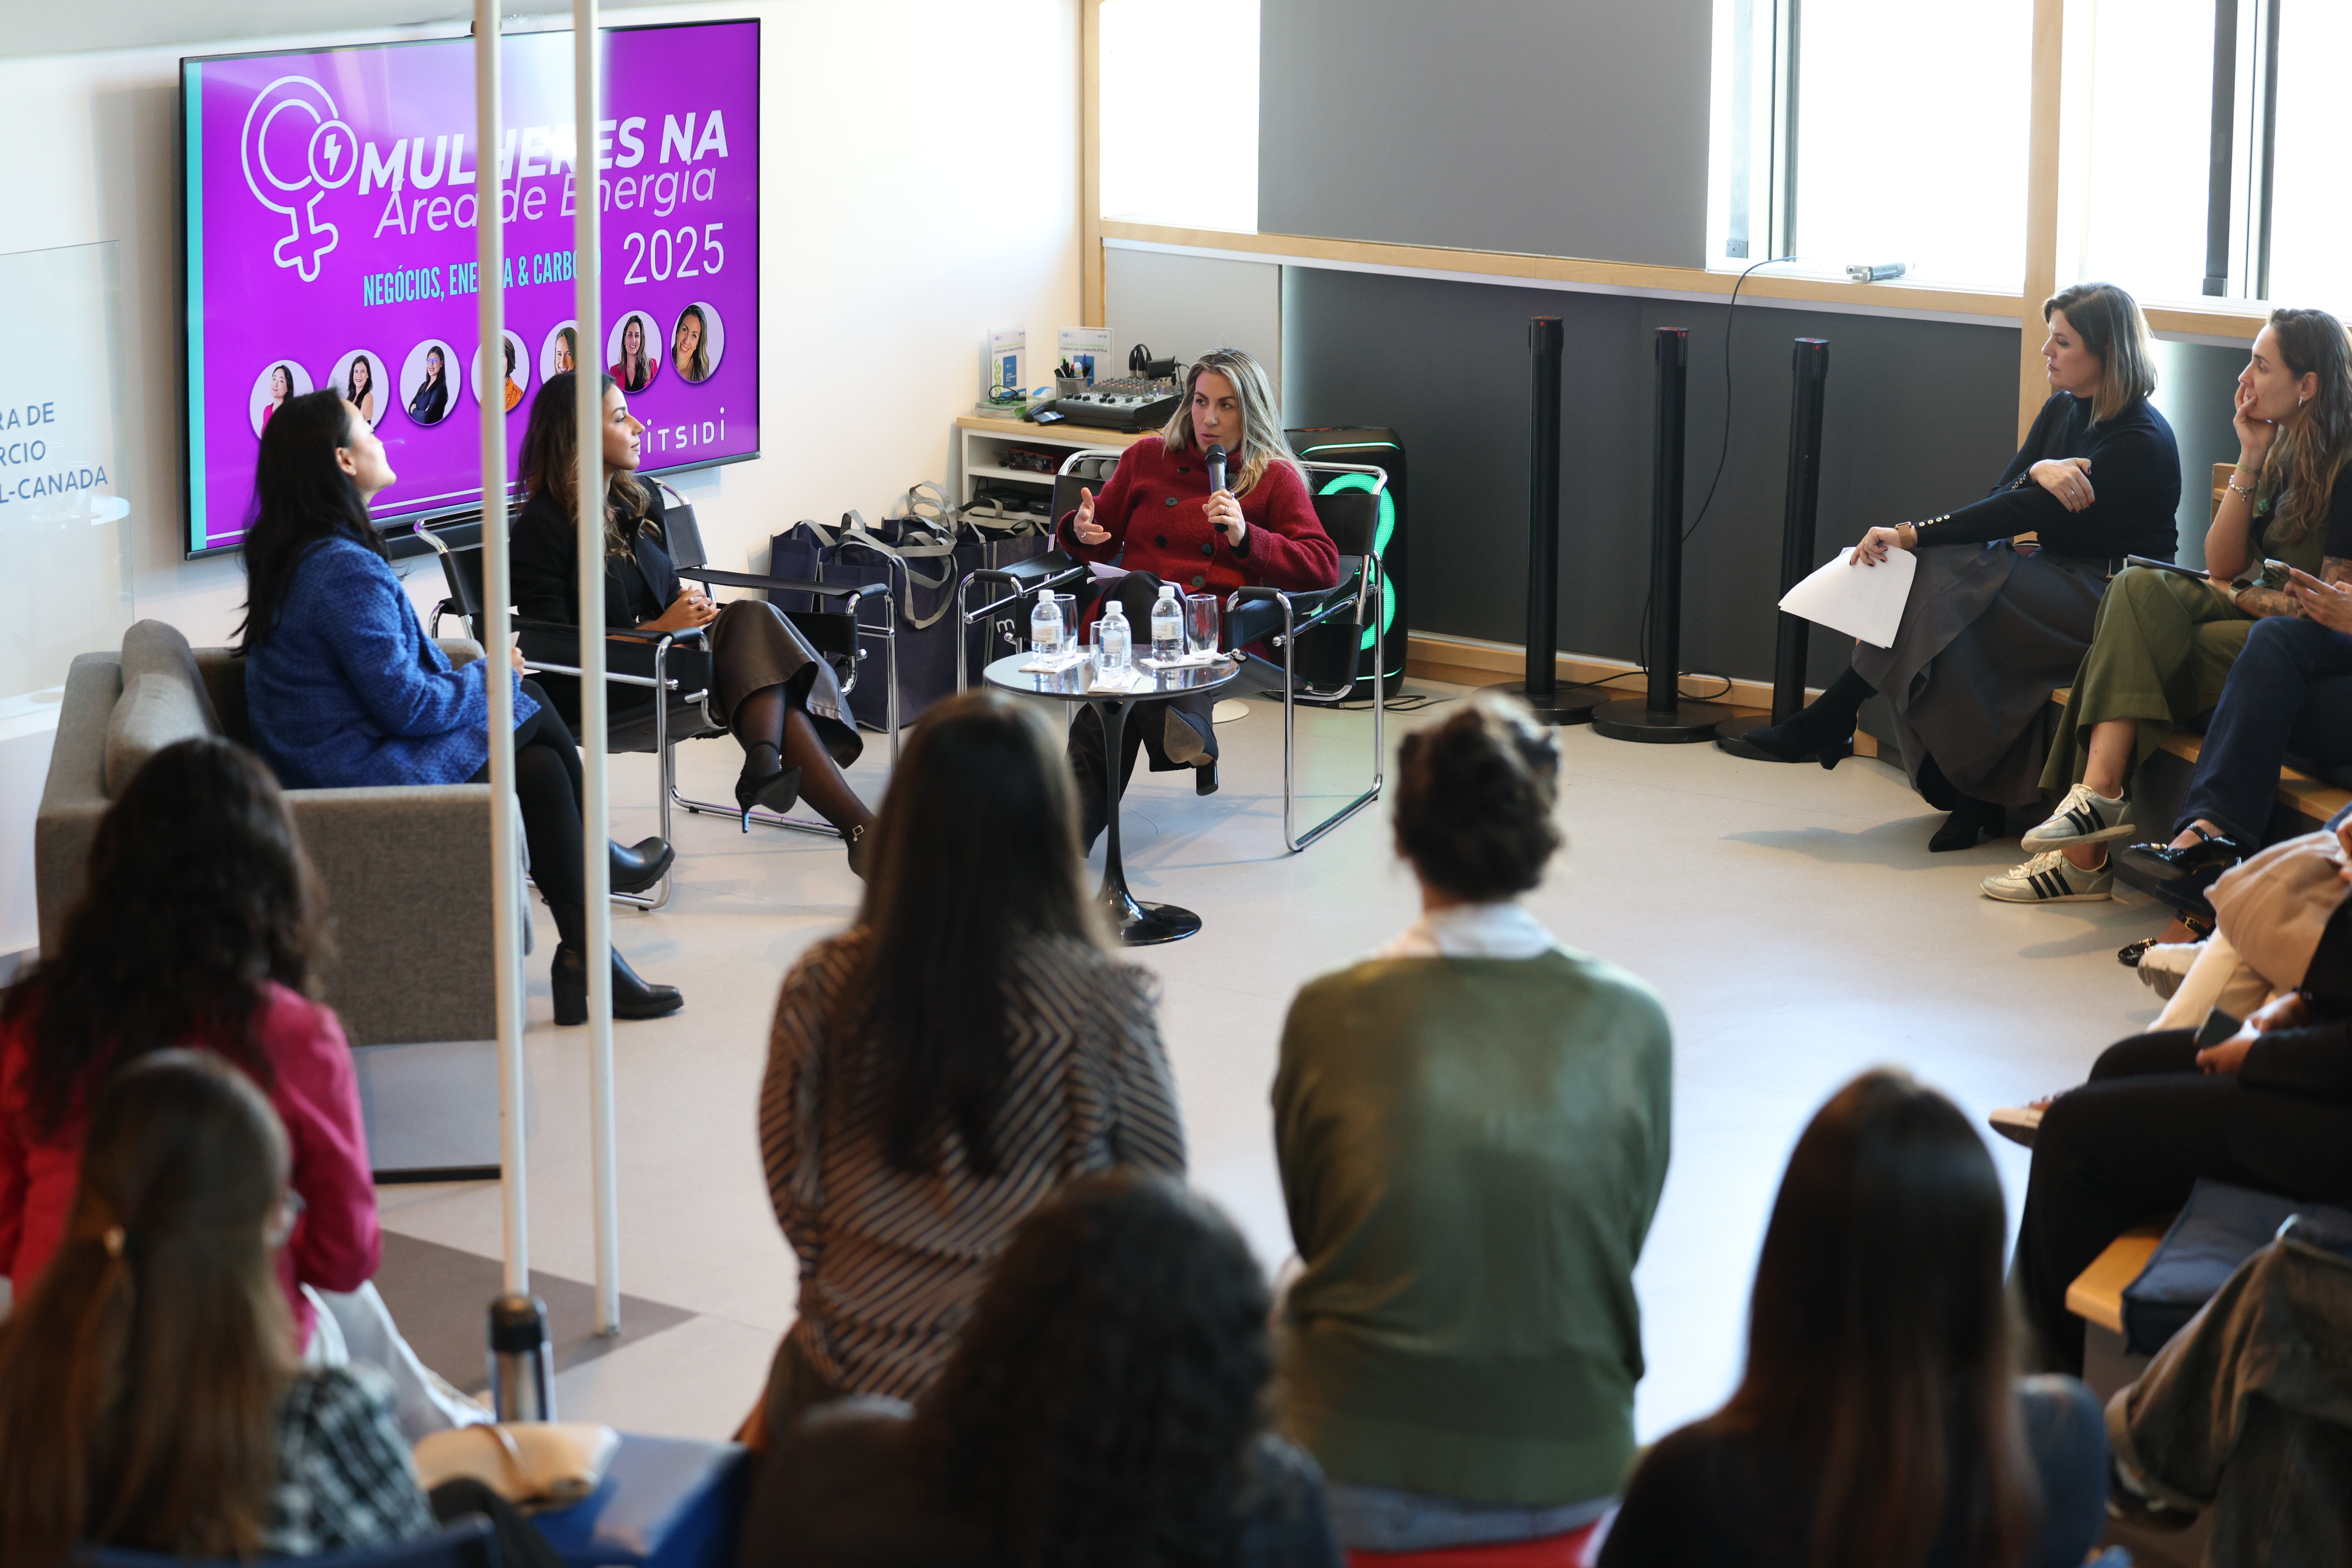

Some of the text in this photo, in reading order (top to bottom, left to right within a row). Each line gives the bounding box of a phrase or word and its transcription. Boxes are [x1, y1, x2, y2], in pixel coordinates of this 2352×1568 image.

[659, 110, 728, 164] NA
[373, 158, 716, 238] Área de Energia
[623, 222, 724, 285] 2025
[363, 265, 445, 307] NEGÓCIOS,
[449, 257, 513, 295] ENEA
[518, 255, 529, 286] &
[27, 402, 55, 426] DE
